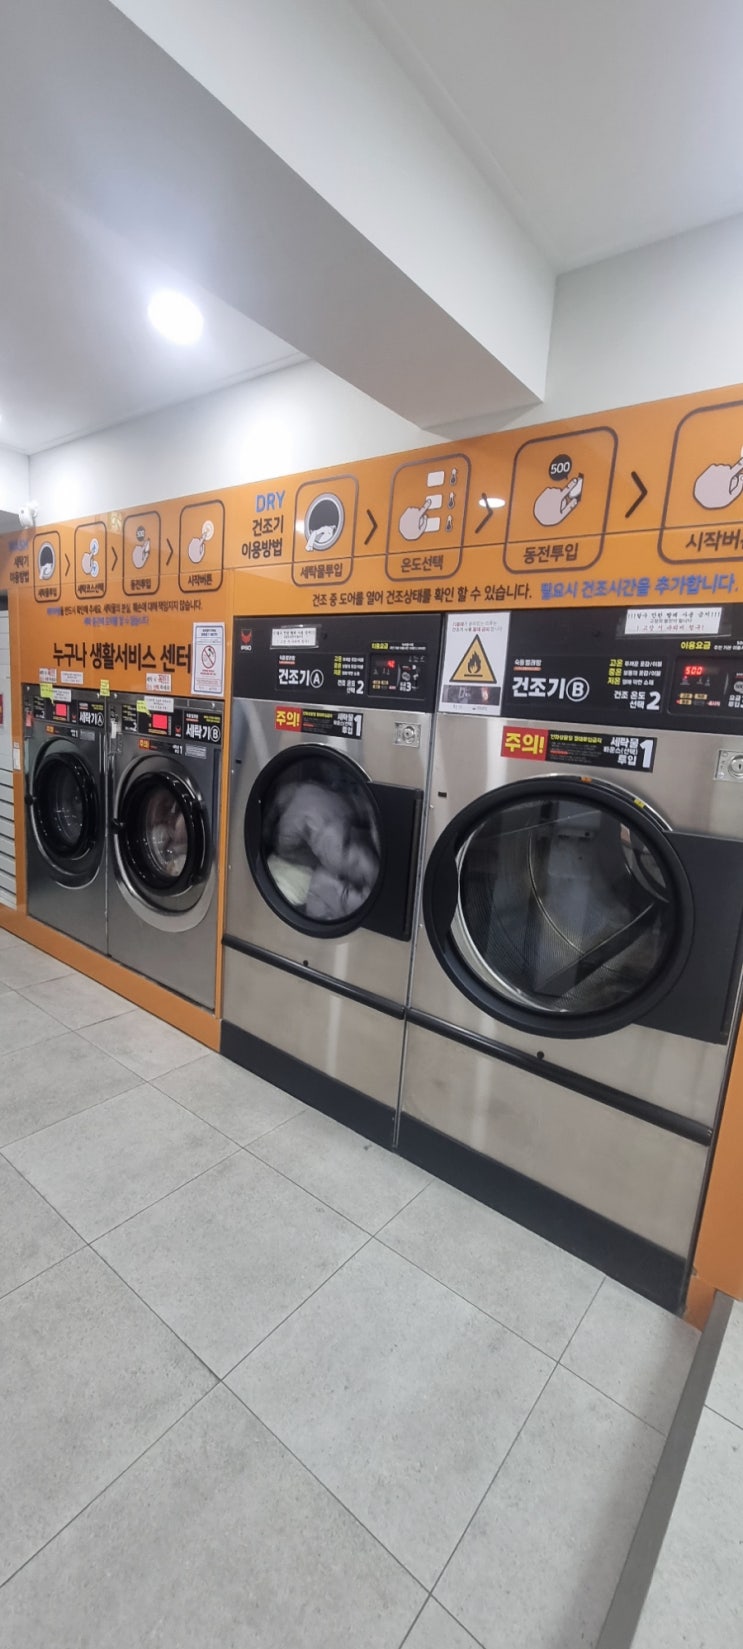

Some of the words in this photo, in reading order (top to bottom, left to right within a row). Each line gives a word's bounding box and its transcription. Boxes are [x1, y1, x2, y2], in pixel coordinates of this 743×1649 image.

[550, 461, 570, 474] 500
[255, 490, 286, 513] DRY
[252, 515, 284, 537] 건조기
[241, 538, 283, 560] 이용방법
[686, 529, 743, 552] 시작버
[523, 543, 579, 565] 동전투입
[300, 563, 343, 580] 세탁물투입
[401, 555, 444, 573] 온도선택
[188, 573, 213, 586] 시작버튼
[312, 594, 328, 607] 건조
[329, 594, 337, 607] 중
[340, 593, 364, 606] 도어를
[366, 590, 384, 605] 열어
[386, 588, 432, 605] 건조상태를
[434, 587, 454, 603] 확인
[457, 586, 468, 603] 할
[470, 586, 481, 602] 수
[484, 583, 532, 601] 있습니다.
[540, 581, 578, 601] 필요시
[582, 577, 651, 599] 건조시간을
[655, 573, 739, 596] 추가합니다.
[680, 641, 711, 650] 이용요금
[53, 642, 87, 668] 누구나
[90, 642, 157, 671] 생활서비스
[160, 643, 191, 674] 센터
[609, 659, 623, 667] 고온
[608, 668, 622, 677] 중온
[684, 665, 703, 676] 500
[356, 680, 364, 694] 2
[406, 682, 412, 692] 3
[607, 677, 621, 686] 저온
[614, 690, 629, 699] 건조
[630, 691, 646, 700] 온도
[629, 700, 645, 709] 선택
[646, 691, 661, 710] 2
[276, 710, 300, 727] 주의!
[354, 714, 362, 737] 1
[504, 732, 545, 755] 주의!
[610, 736, 639, 749] 세탁물
[617, 755, 637, 766] 투입
[640, 739, 653, 768] 1
